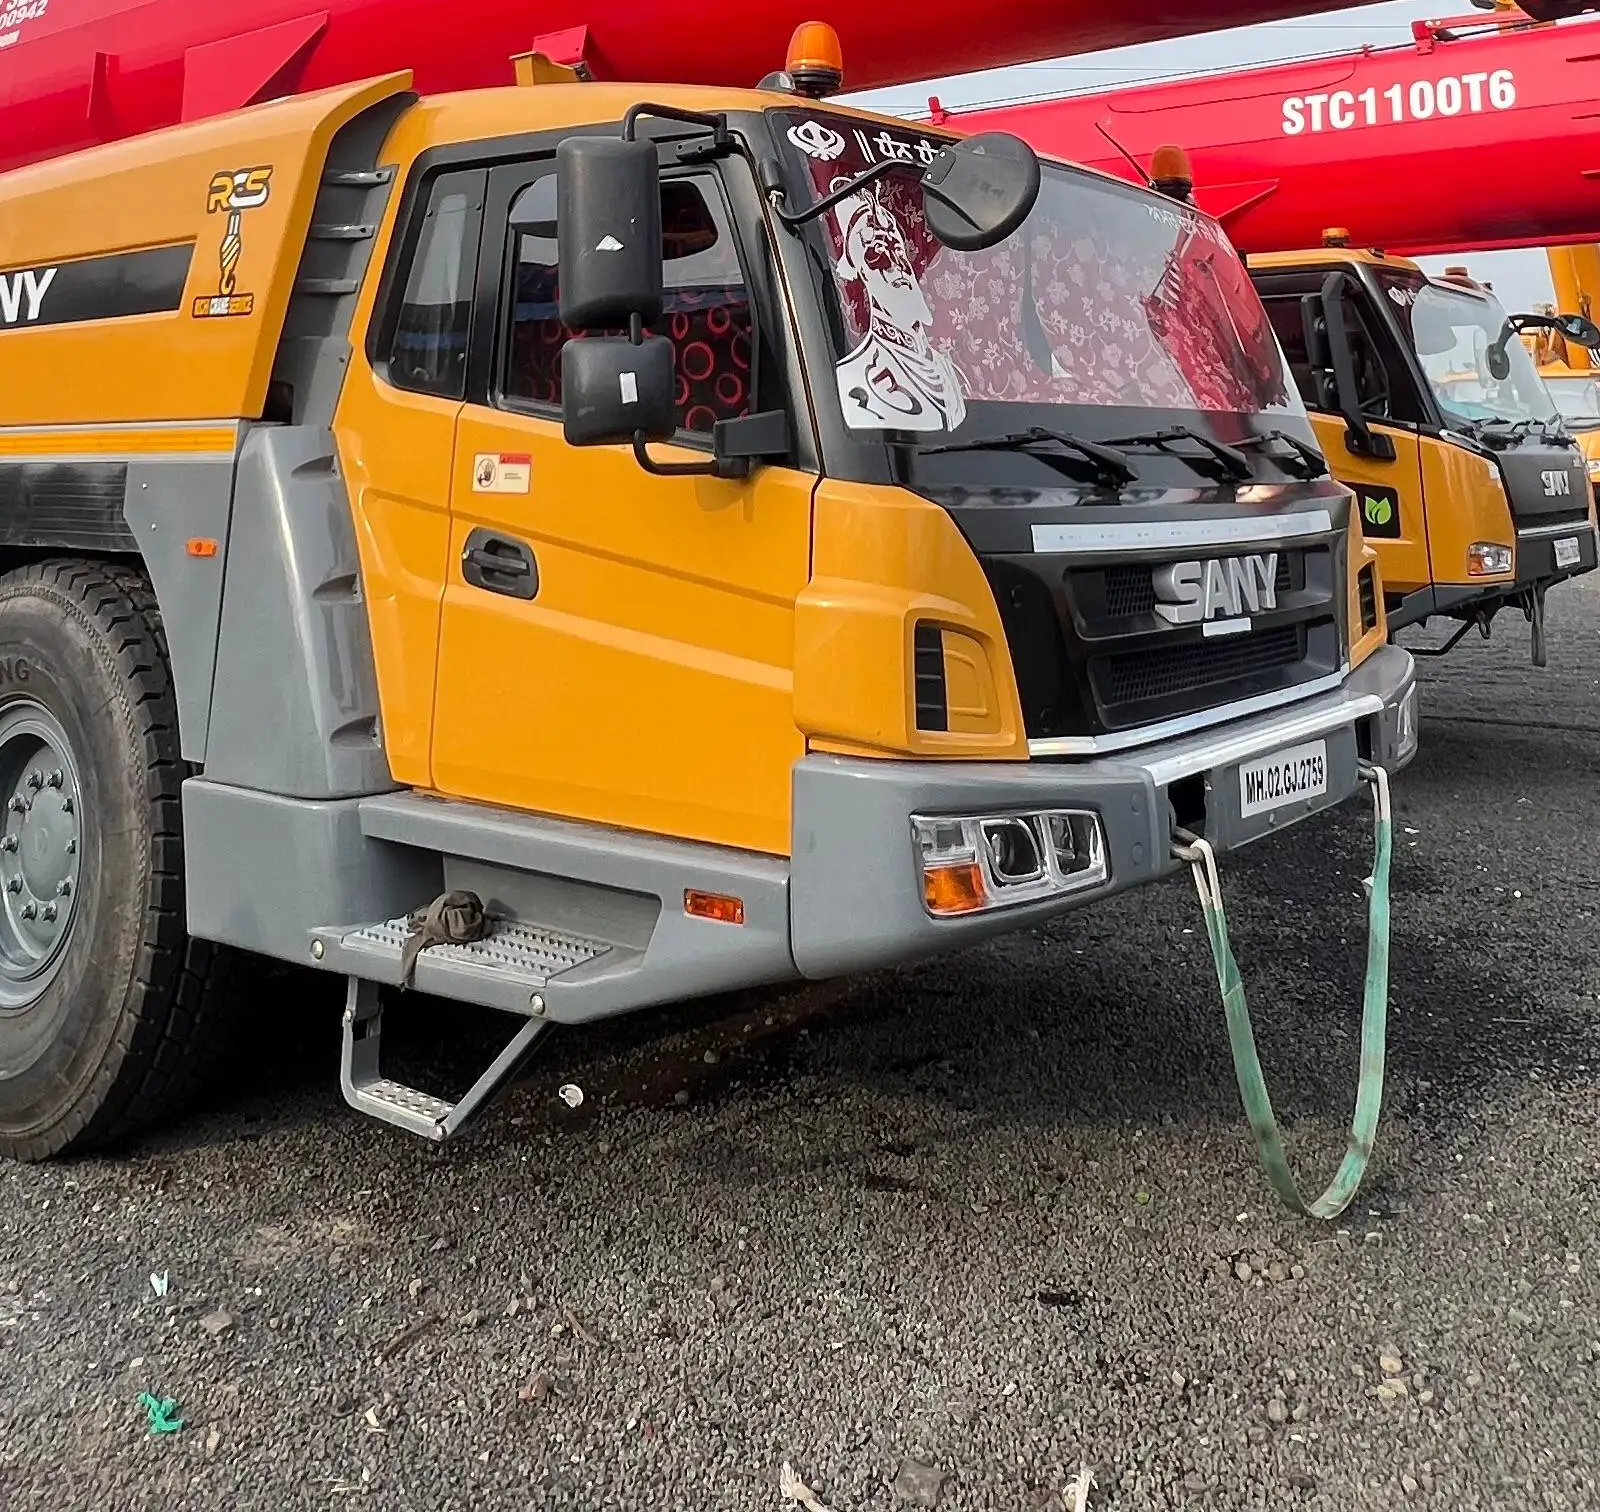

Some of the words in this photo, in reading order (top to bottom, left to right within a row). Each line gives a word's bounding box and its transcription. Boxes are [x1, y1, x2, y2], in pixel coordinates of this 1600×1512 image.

[1281, 69, 1516, 135] STC1100T6
[1152, 553, 1278, 624] SANY
[1245, 755, 1324, 805] MH.02.GJ.2759
